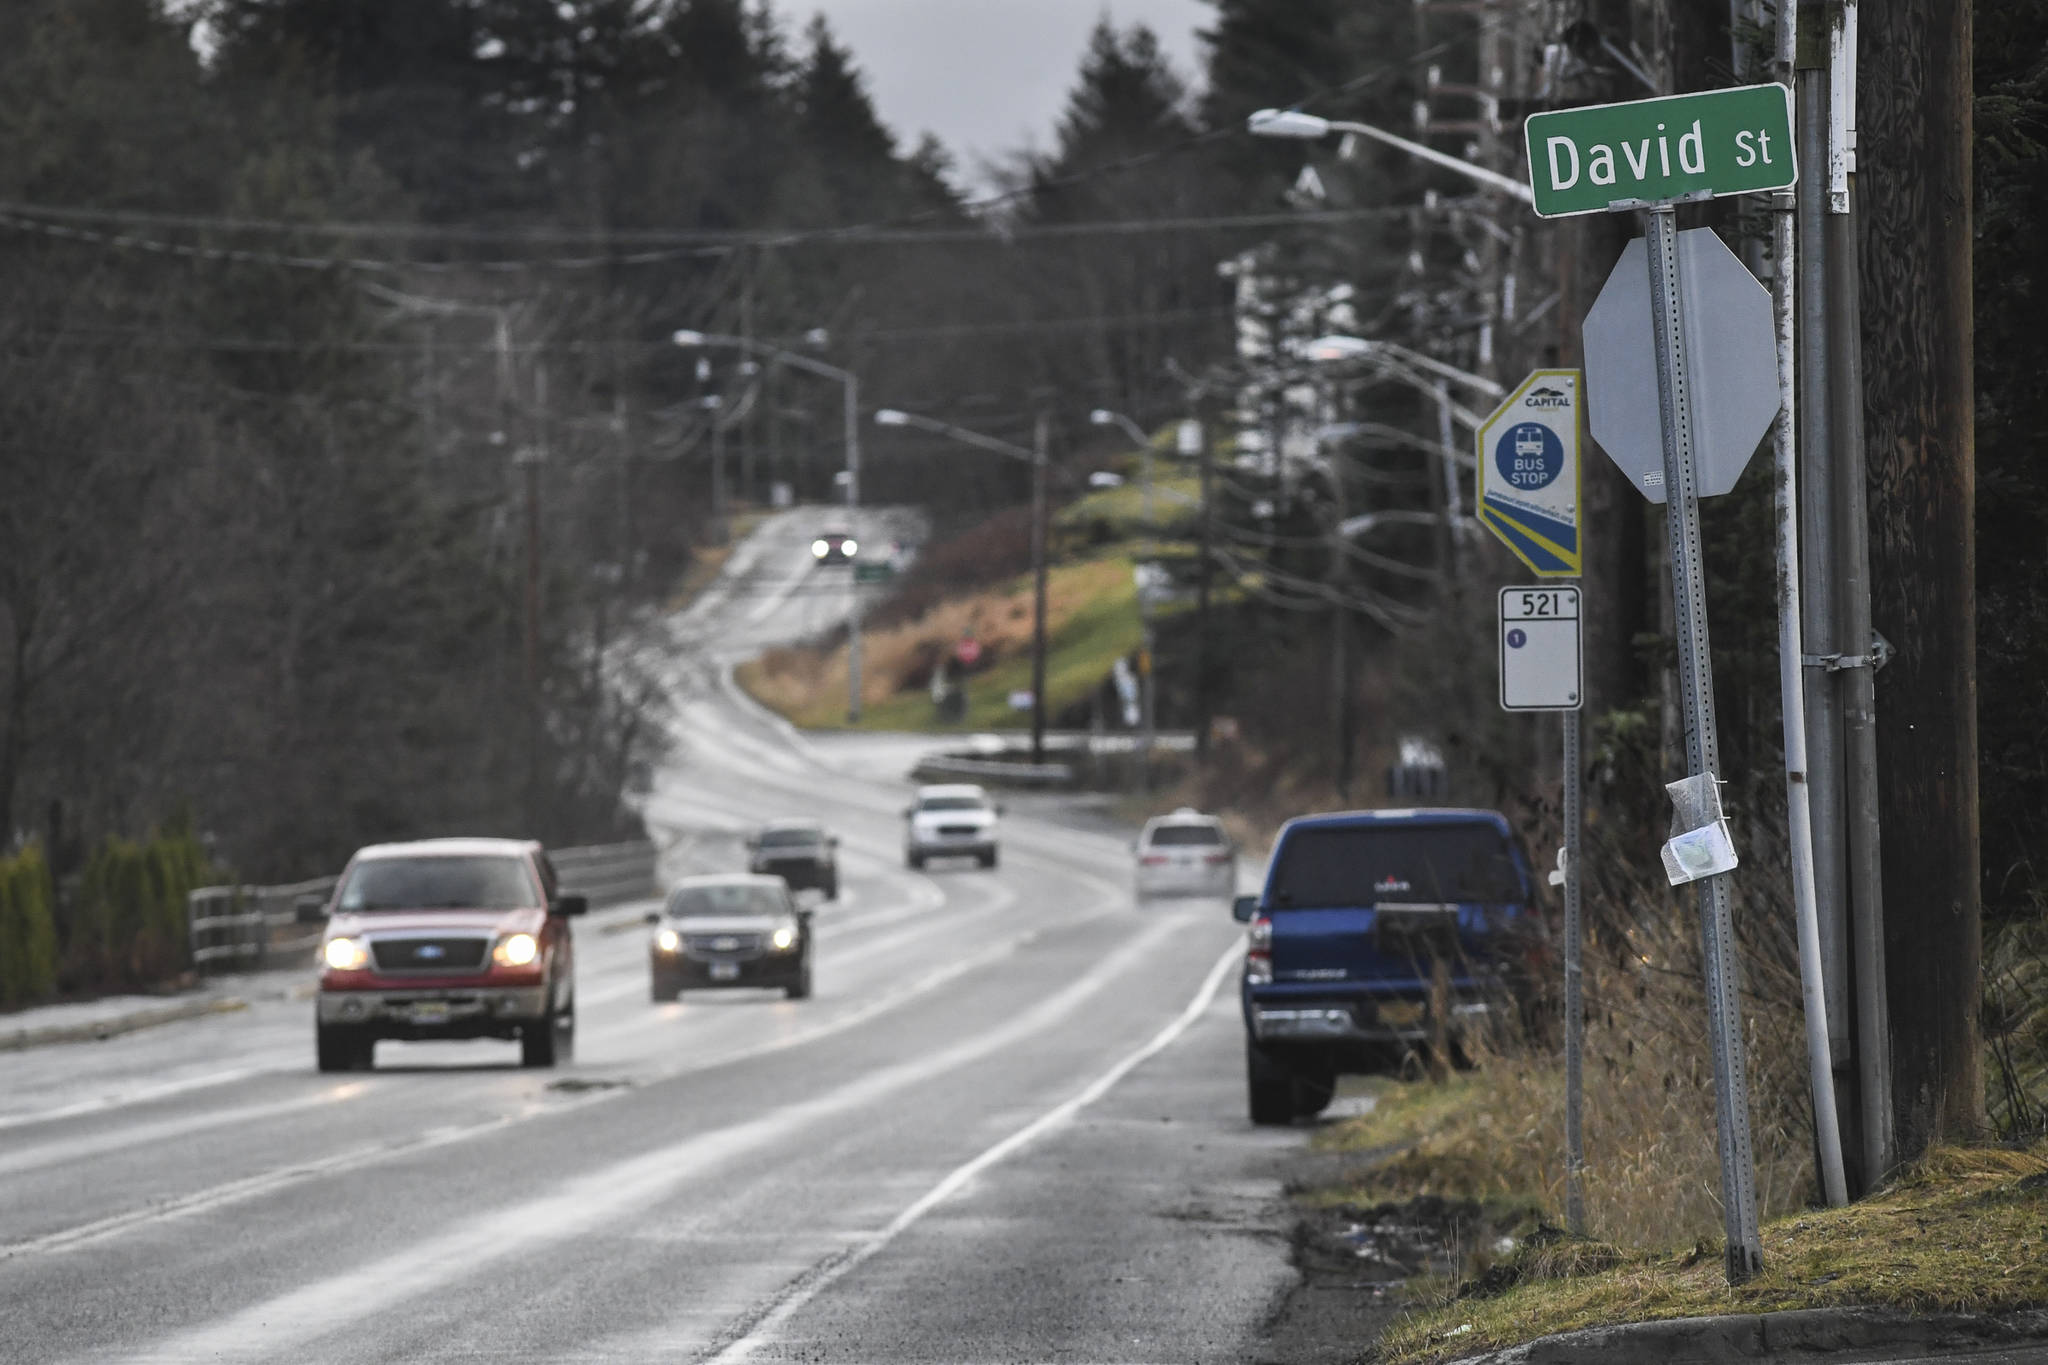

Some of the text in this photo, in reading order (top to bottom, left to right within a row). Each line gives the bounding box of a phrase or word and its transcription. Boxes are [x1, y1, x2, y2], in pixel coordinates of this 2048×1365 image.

[1546, 119, 1773, 191] David St
[1525, 397, 1570, 407] CAPITAL
[1514, 458, 1545, 470] BUS
[1511, 472, 1549, 485] STOP
[1523, 593, 1558, 616] 521
